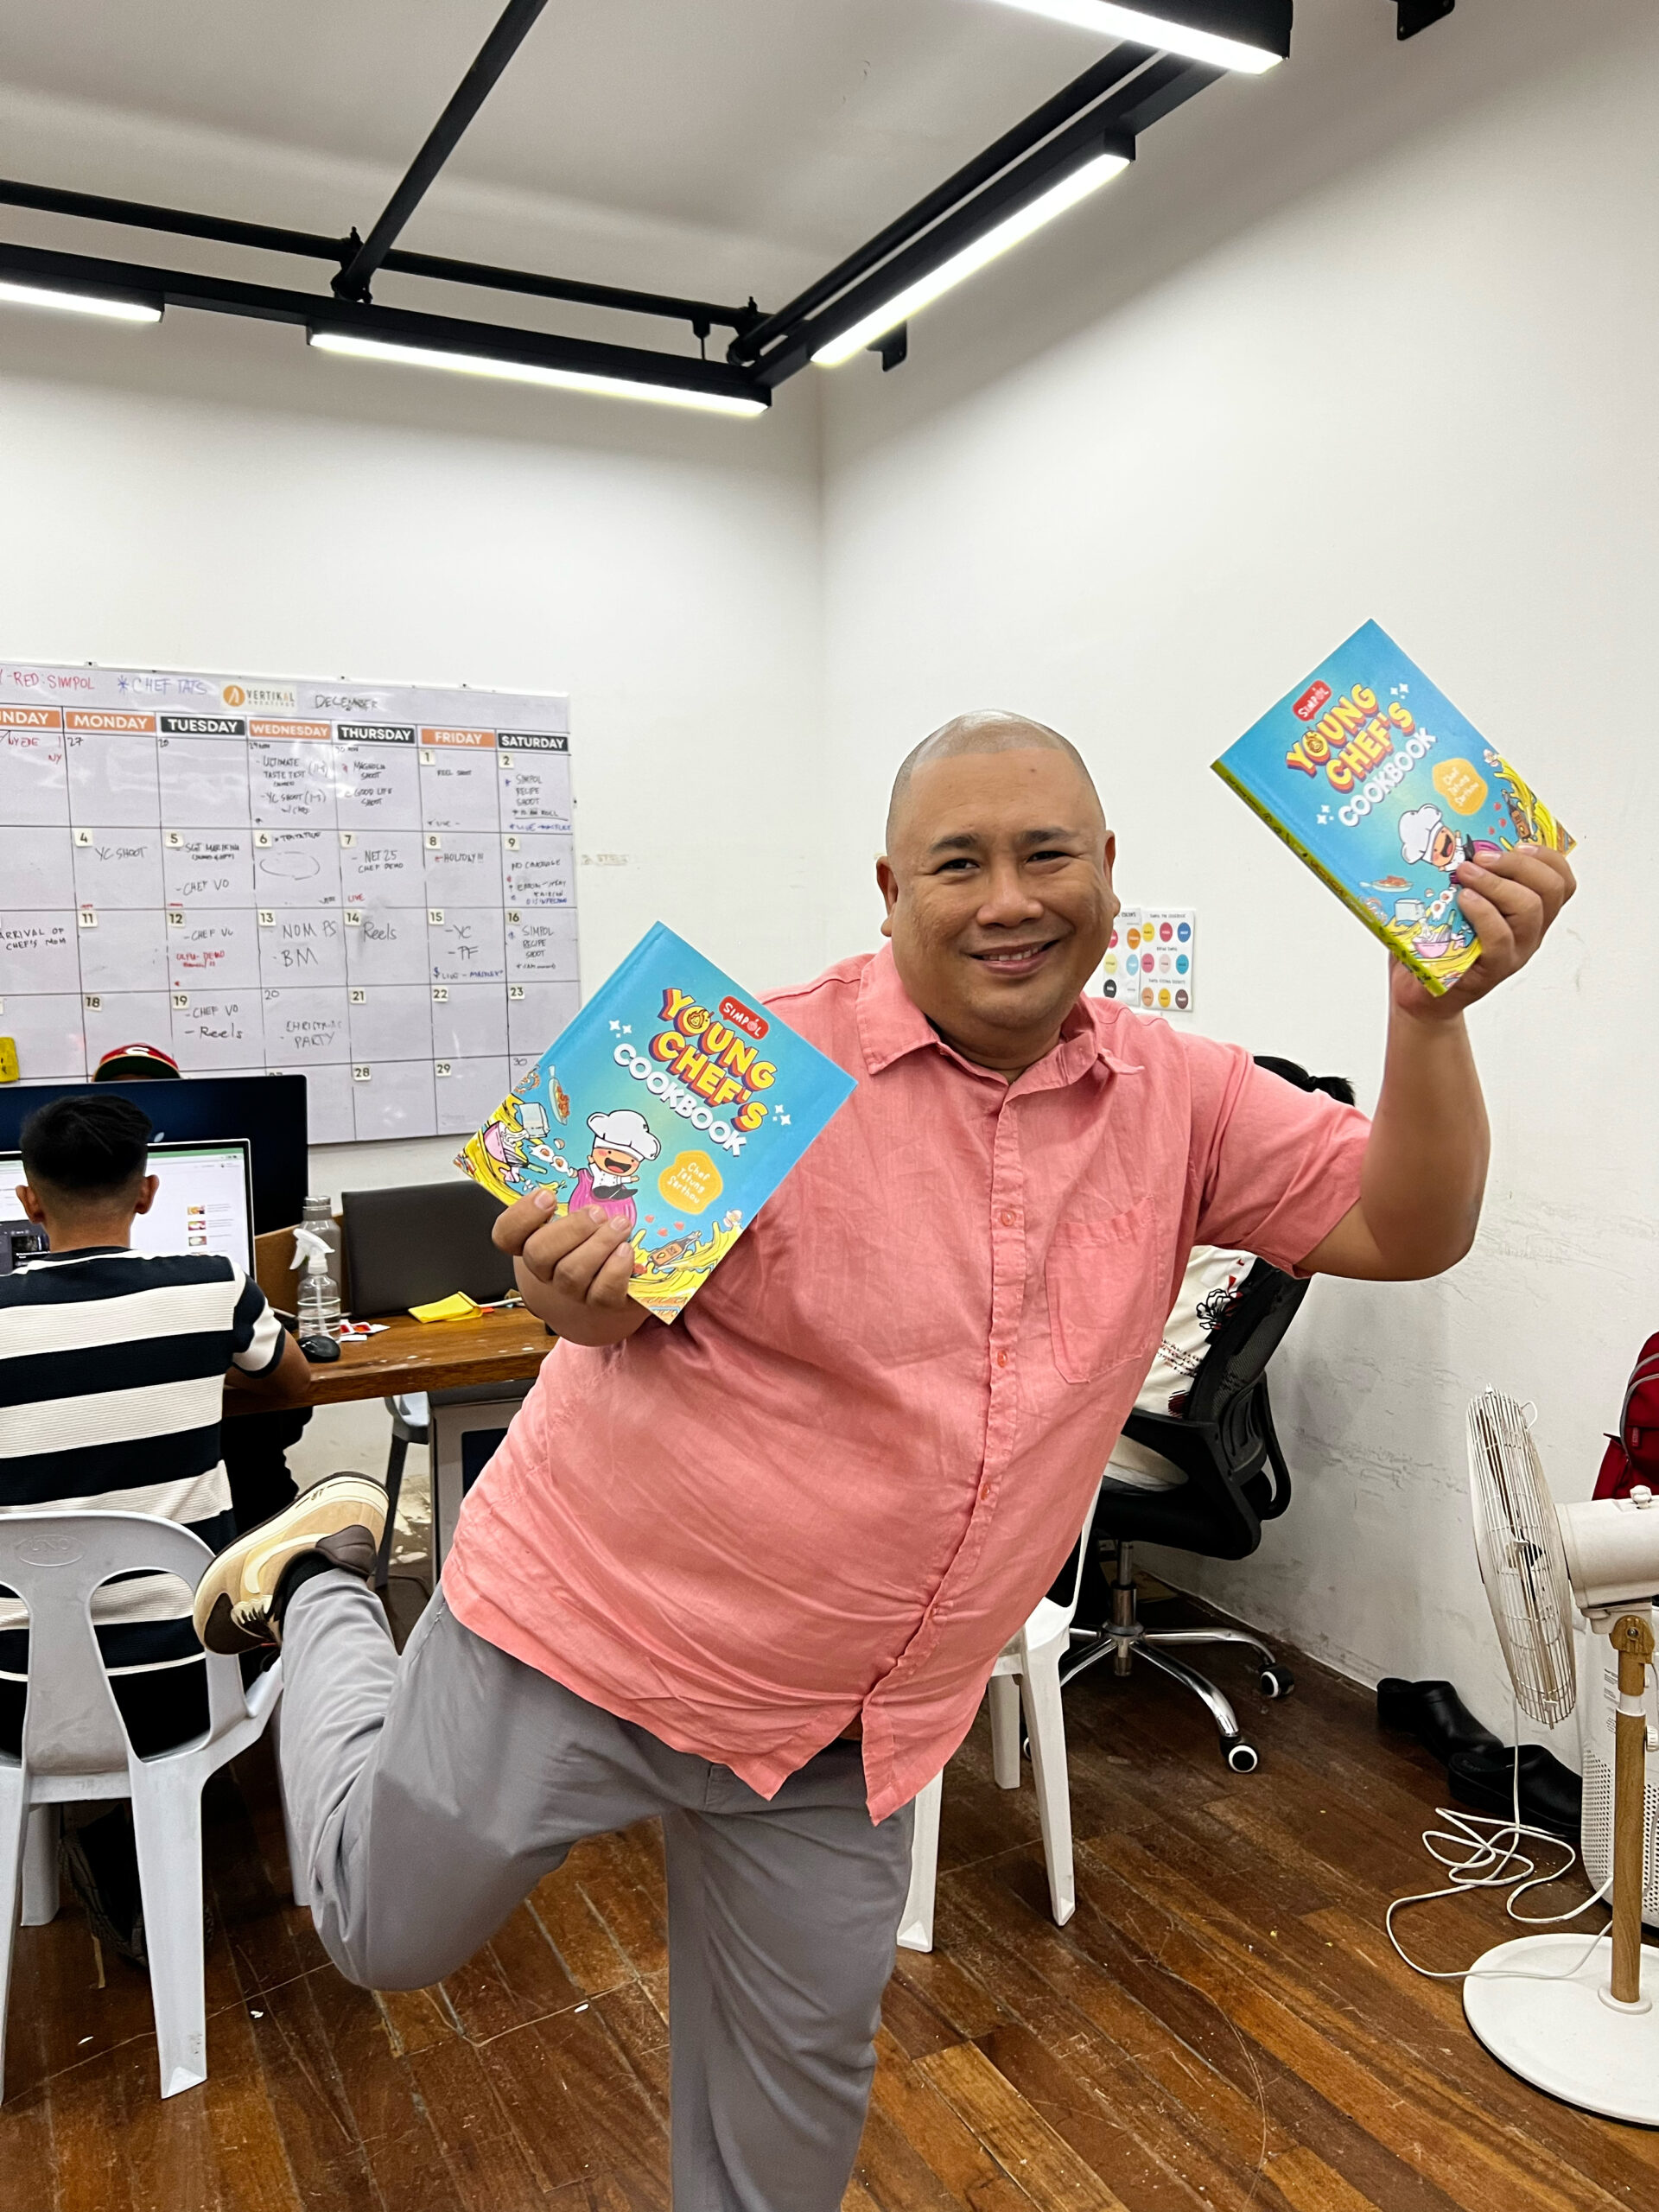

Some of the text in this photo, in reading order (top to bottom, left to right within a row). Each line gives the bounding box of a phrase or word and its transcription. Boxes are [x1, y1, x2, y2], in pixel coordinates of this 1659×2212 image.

[247, 690, 295, 702] VERTIKAL
[0, 710, 49, 725] NDAY
[74, 715, 148, 729] MONDAY
[168, 718, 238, 733] TUESDAY
[251, 723, 328, 737] WEDNESDAY
[1286, 683, 1379, 779] YOUNG
[340, 727, 411, 741] THURSDAY
[435, 731, 482, 744] FRIDAY
[501, 736, 563, 749] SATURDAY
[1325, 702, 1415, 794] CHEF'S
[424, 752, 430, 762] 1
[503, 755, 510, 766] 2
[1338, 727, 1438, 827] COOKBOOK
[80, 833, 88, 842] 4
[170, 833, 178, 843] 5
[259, 834, 268, 844] 6
[345, 835, 352, 844] 7
[429, 836, 436, 846] 8
[508, 838, 515, 848] 9
[95, 847, 147, 861] YC SHOOT
[365, 850, 382, 862] NET
[213, 879, 229, 891] VO
[82, 913, 93, 923] 11
[169, 913, 183, 924] 12
[261, 912, 274, 922] 13
[346, 912, 359, 922] 14
[430, 912, 442, 922] 15
[508, 912, 520, 922] 16
[191, 929, 215, 941] CHEF
[363, 922, 397, 942] Reels
[522, 925, 555, 937] SIMPOL
[6, 938, 37, 950] CHEF'S
[523, 938, 546, 949] RECIPE
[281, 947, 319, 967] BM
[265, 989, 279, 1001] 20
[353, 991, 365, 1001] 21
[434, 989, 448, 999] 22
[510, 987, 524, 996] 23
[86, 996, 100, 1007] 18
[174, 995, 187, 1005] 19
[193, 1005, 218, 1018] CHEF
[722, 1001, 762, 1038] SIMPOL
[200, 1022, 243, 1039] Reels
[294, 1032, 335, 1049] PARTY
[658, 988, 777, 1092] YOUNG
[513, 1057, 527, 1067] 30
[355, 1067, 370, 1077] 28
[436, 1064, 451, 1074] 29
[649, 1030, 768, 1132] CHEF'S
[613, 1043, 747, 1158] COOKBOOK
[688, 1162, 710, 1181] Chef
[677, 1167, 705, 1194] Tatung
[667, 1175, 701, 1204] Sarthou
